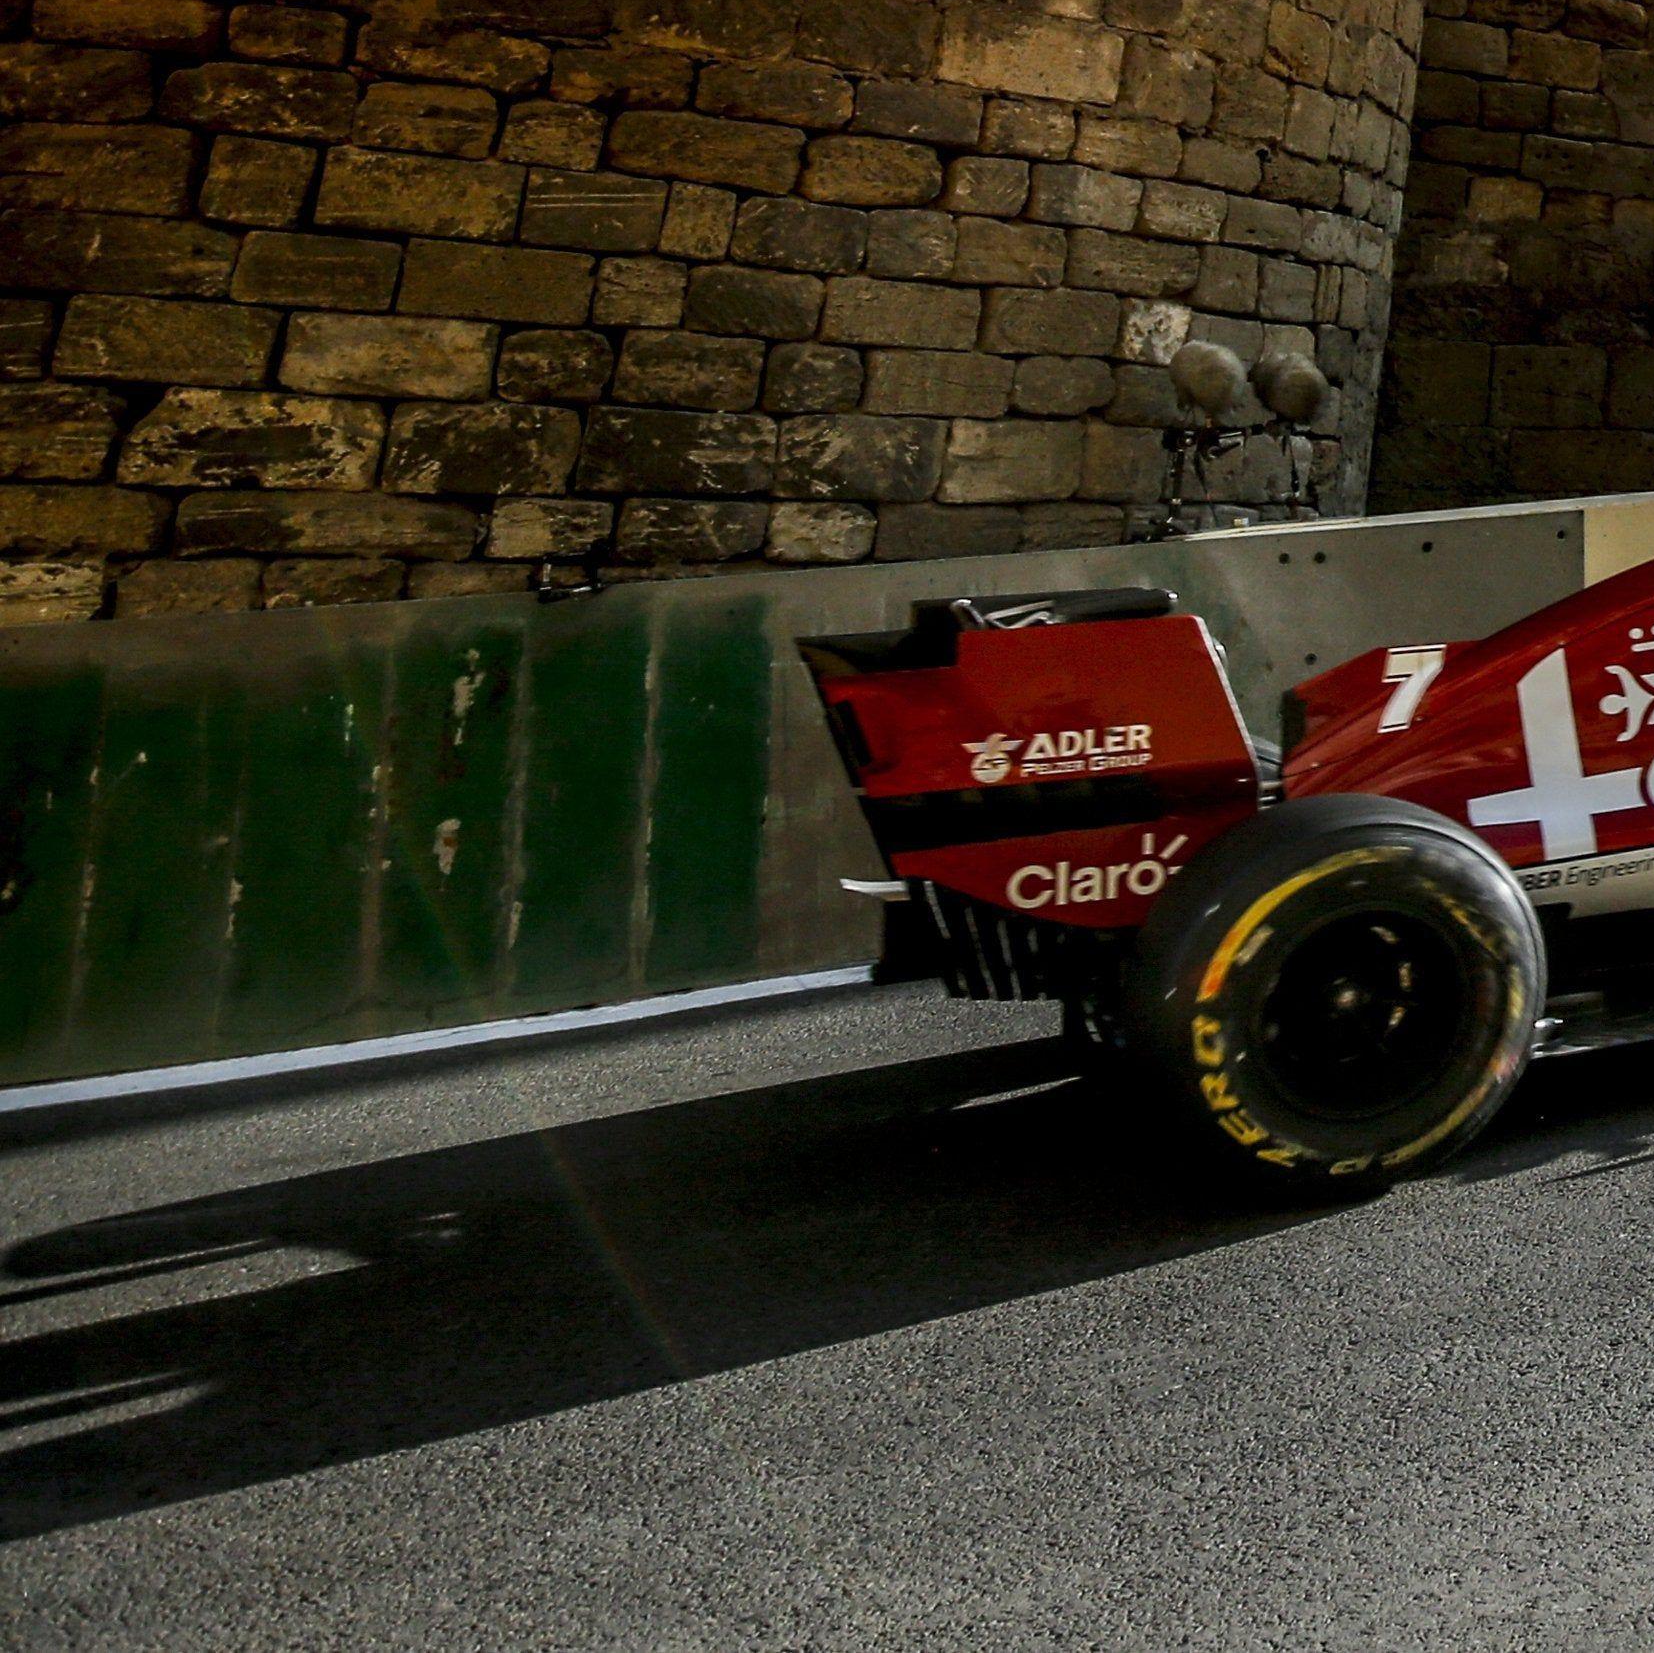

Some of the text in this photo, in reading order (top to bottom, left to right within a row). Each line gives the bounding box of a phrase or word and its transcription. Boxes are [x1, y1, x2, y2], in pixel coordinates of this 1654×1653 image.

[1377, 644, 1447, 734] 7
[1023, 725, 1153, 760] ADLER
[1006, 860, 1167, 909] Claro
[1518, 870, 1561, 891] BER
[1191, 1013, 1300, 1168] ZERO
